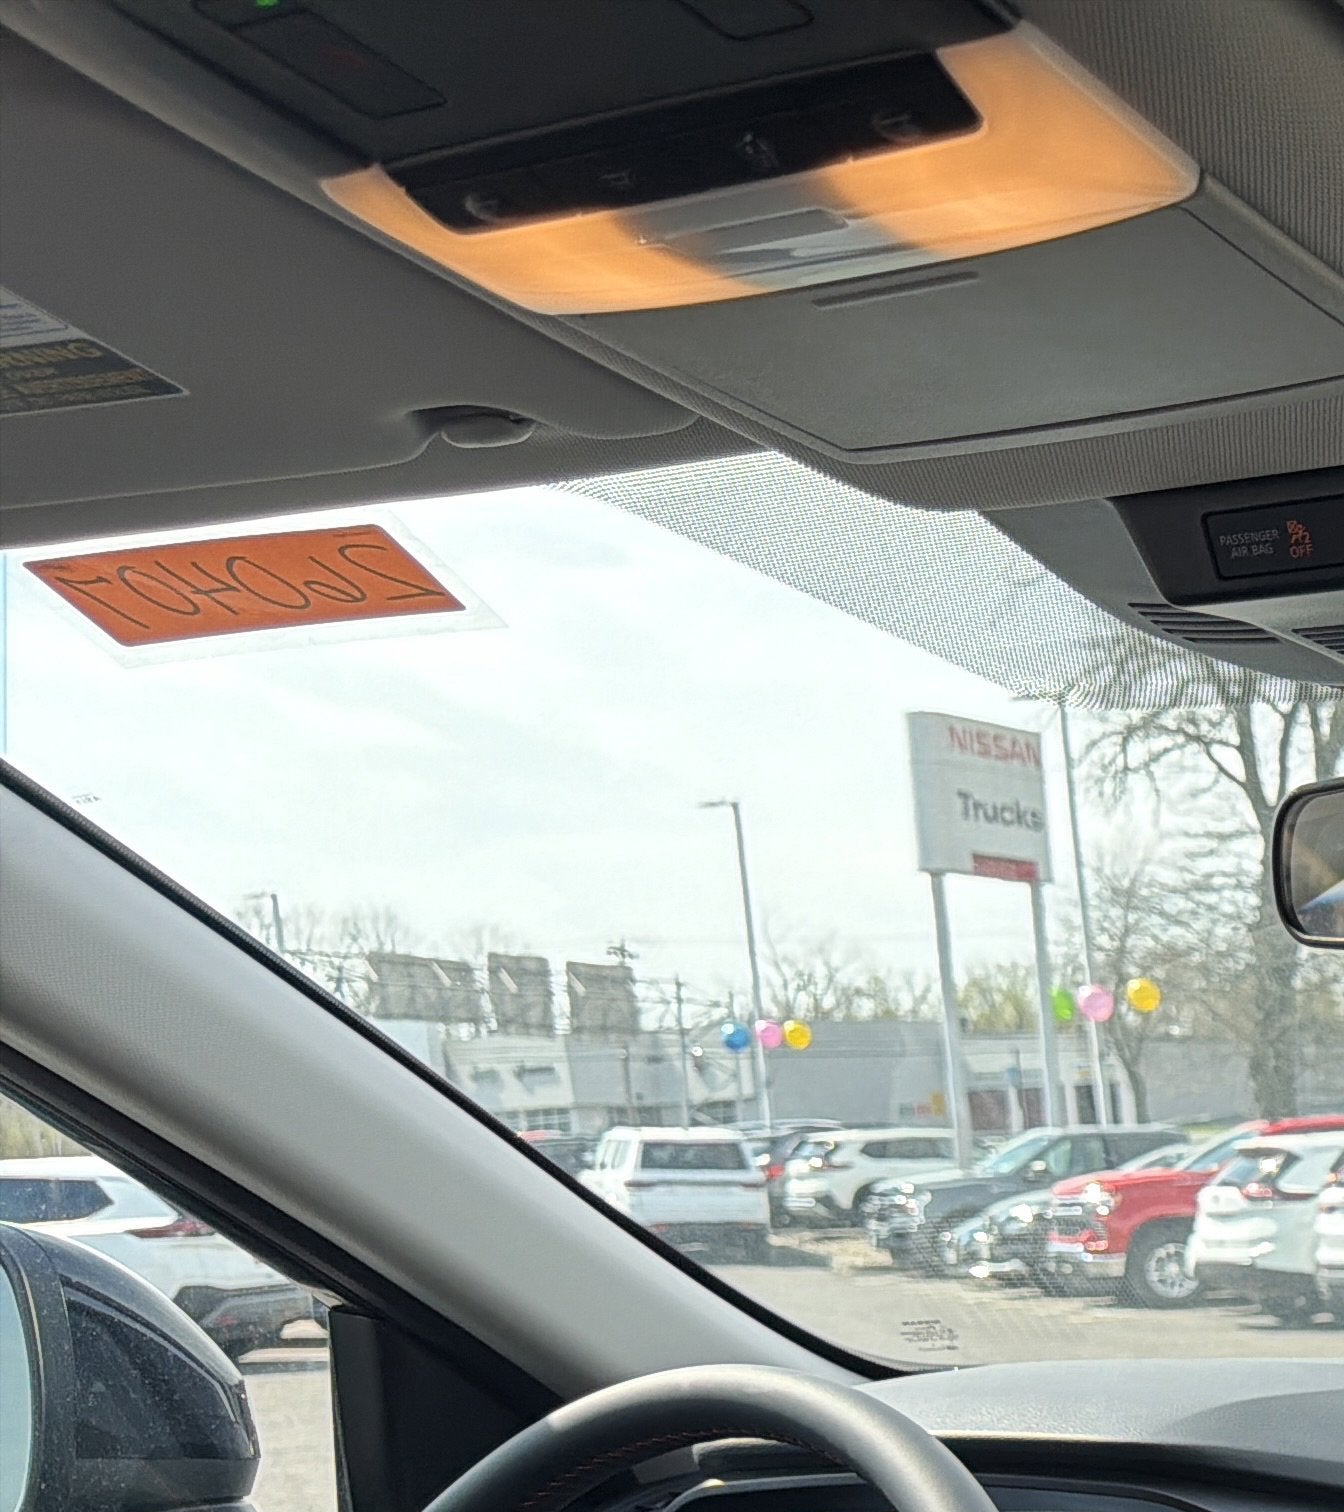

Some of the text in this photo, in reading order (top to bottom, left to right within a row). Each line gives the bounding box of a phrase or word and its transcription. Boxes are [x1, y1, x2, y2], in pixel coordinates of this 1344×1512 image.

[1220, 529, 1280, 546] PASSENGER
[1251, 543, 1274, 556] BAG
[1289, 544, 1313, 558] OFF
[949, 724, 1042, 768] NISSAN
[957, 787, 1045, 833] Trucks
